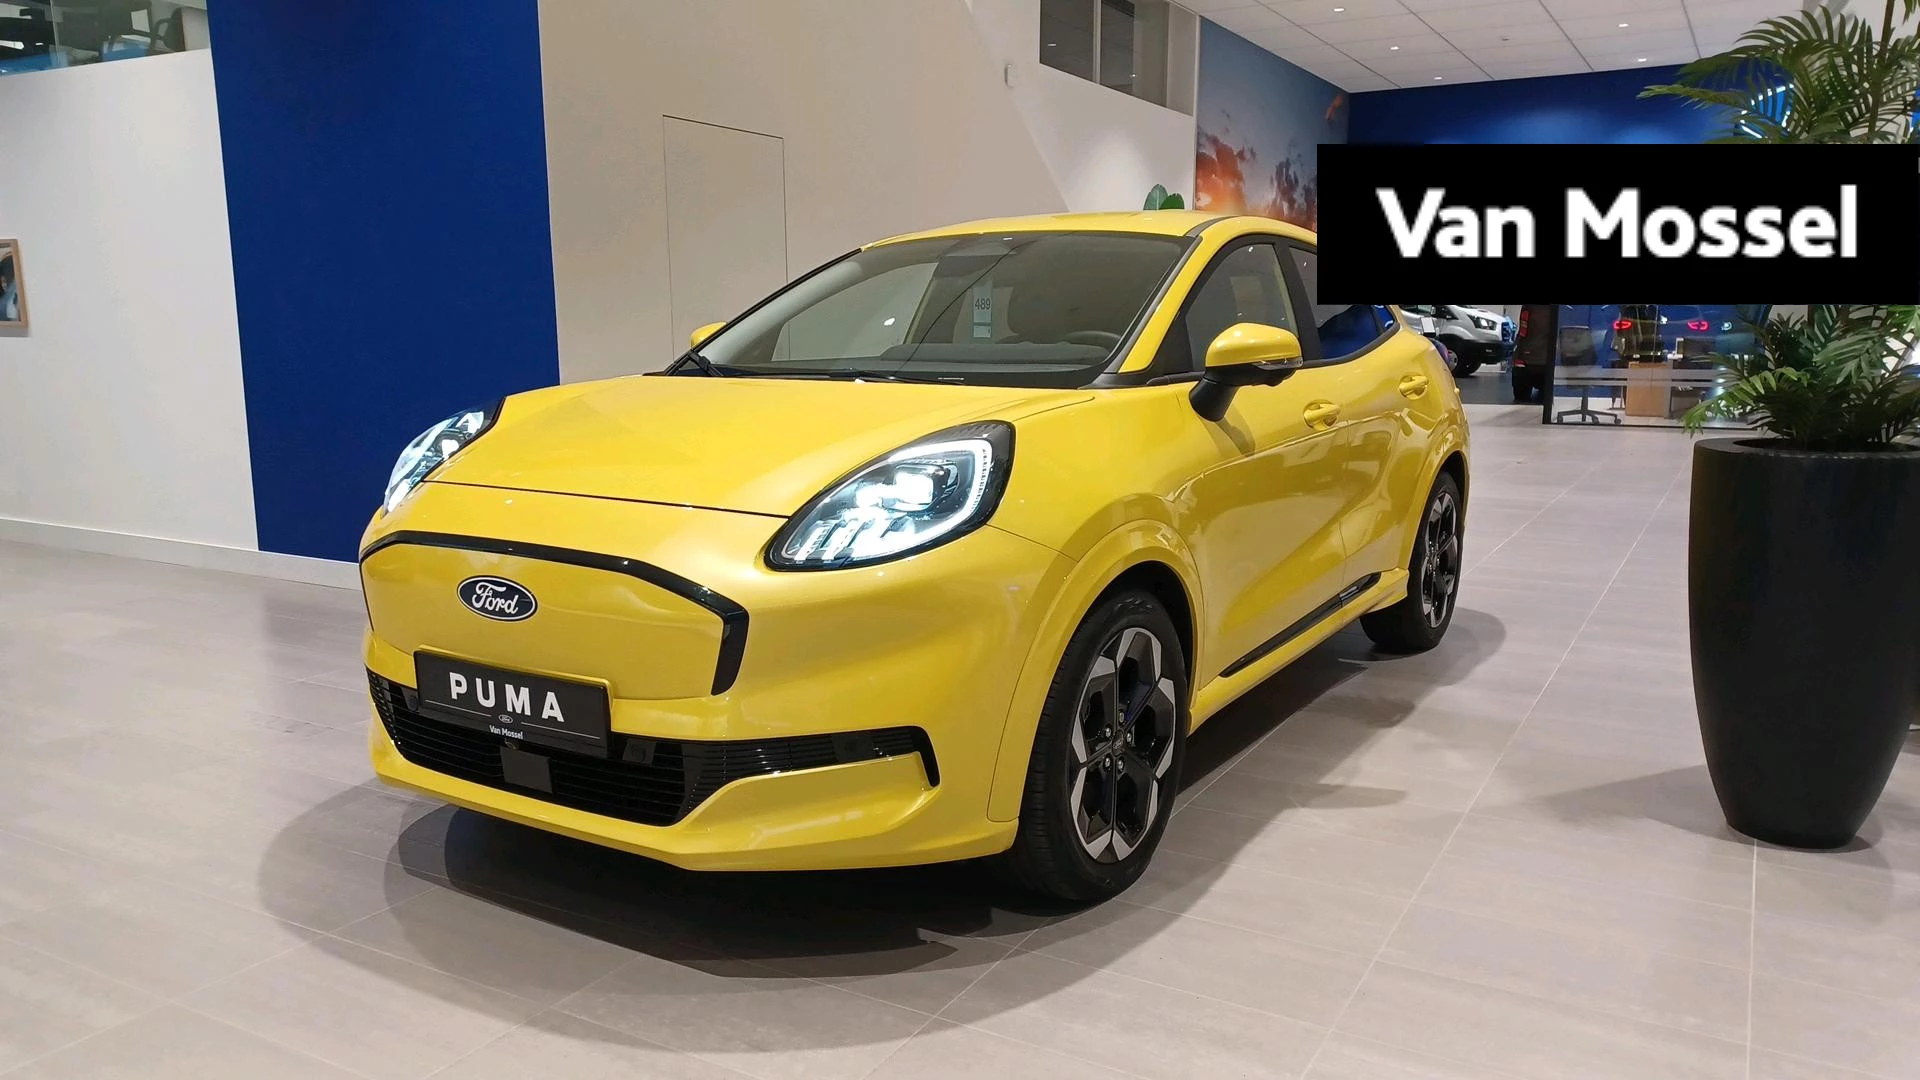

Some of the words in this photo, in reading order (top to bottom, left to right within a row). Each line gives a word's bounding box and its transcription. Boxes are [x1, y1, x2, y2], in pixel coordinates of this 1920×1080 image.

[975, 298, 991, 310] 489
[472, 581, 519, 615] Ford
[449, 672, 565, 722] PUMA
[489, 725, 501, 735] Van
[501, 728, 523, 740] Mossel
